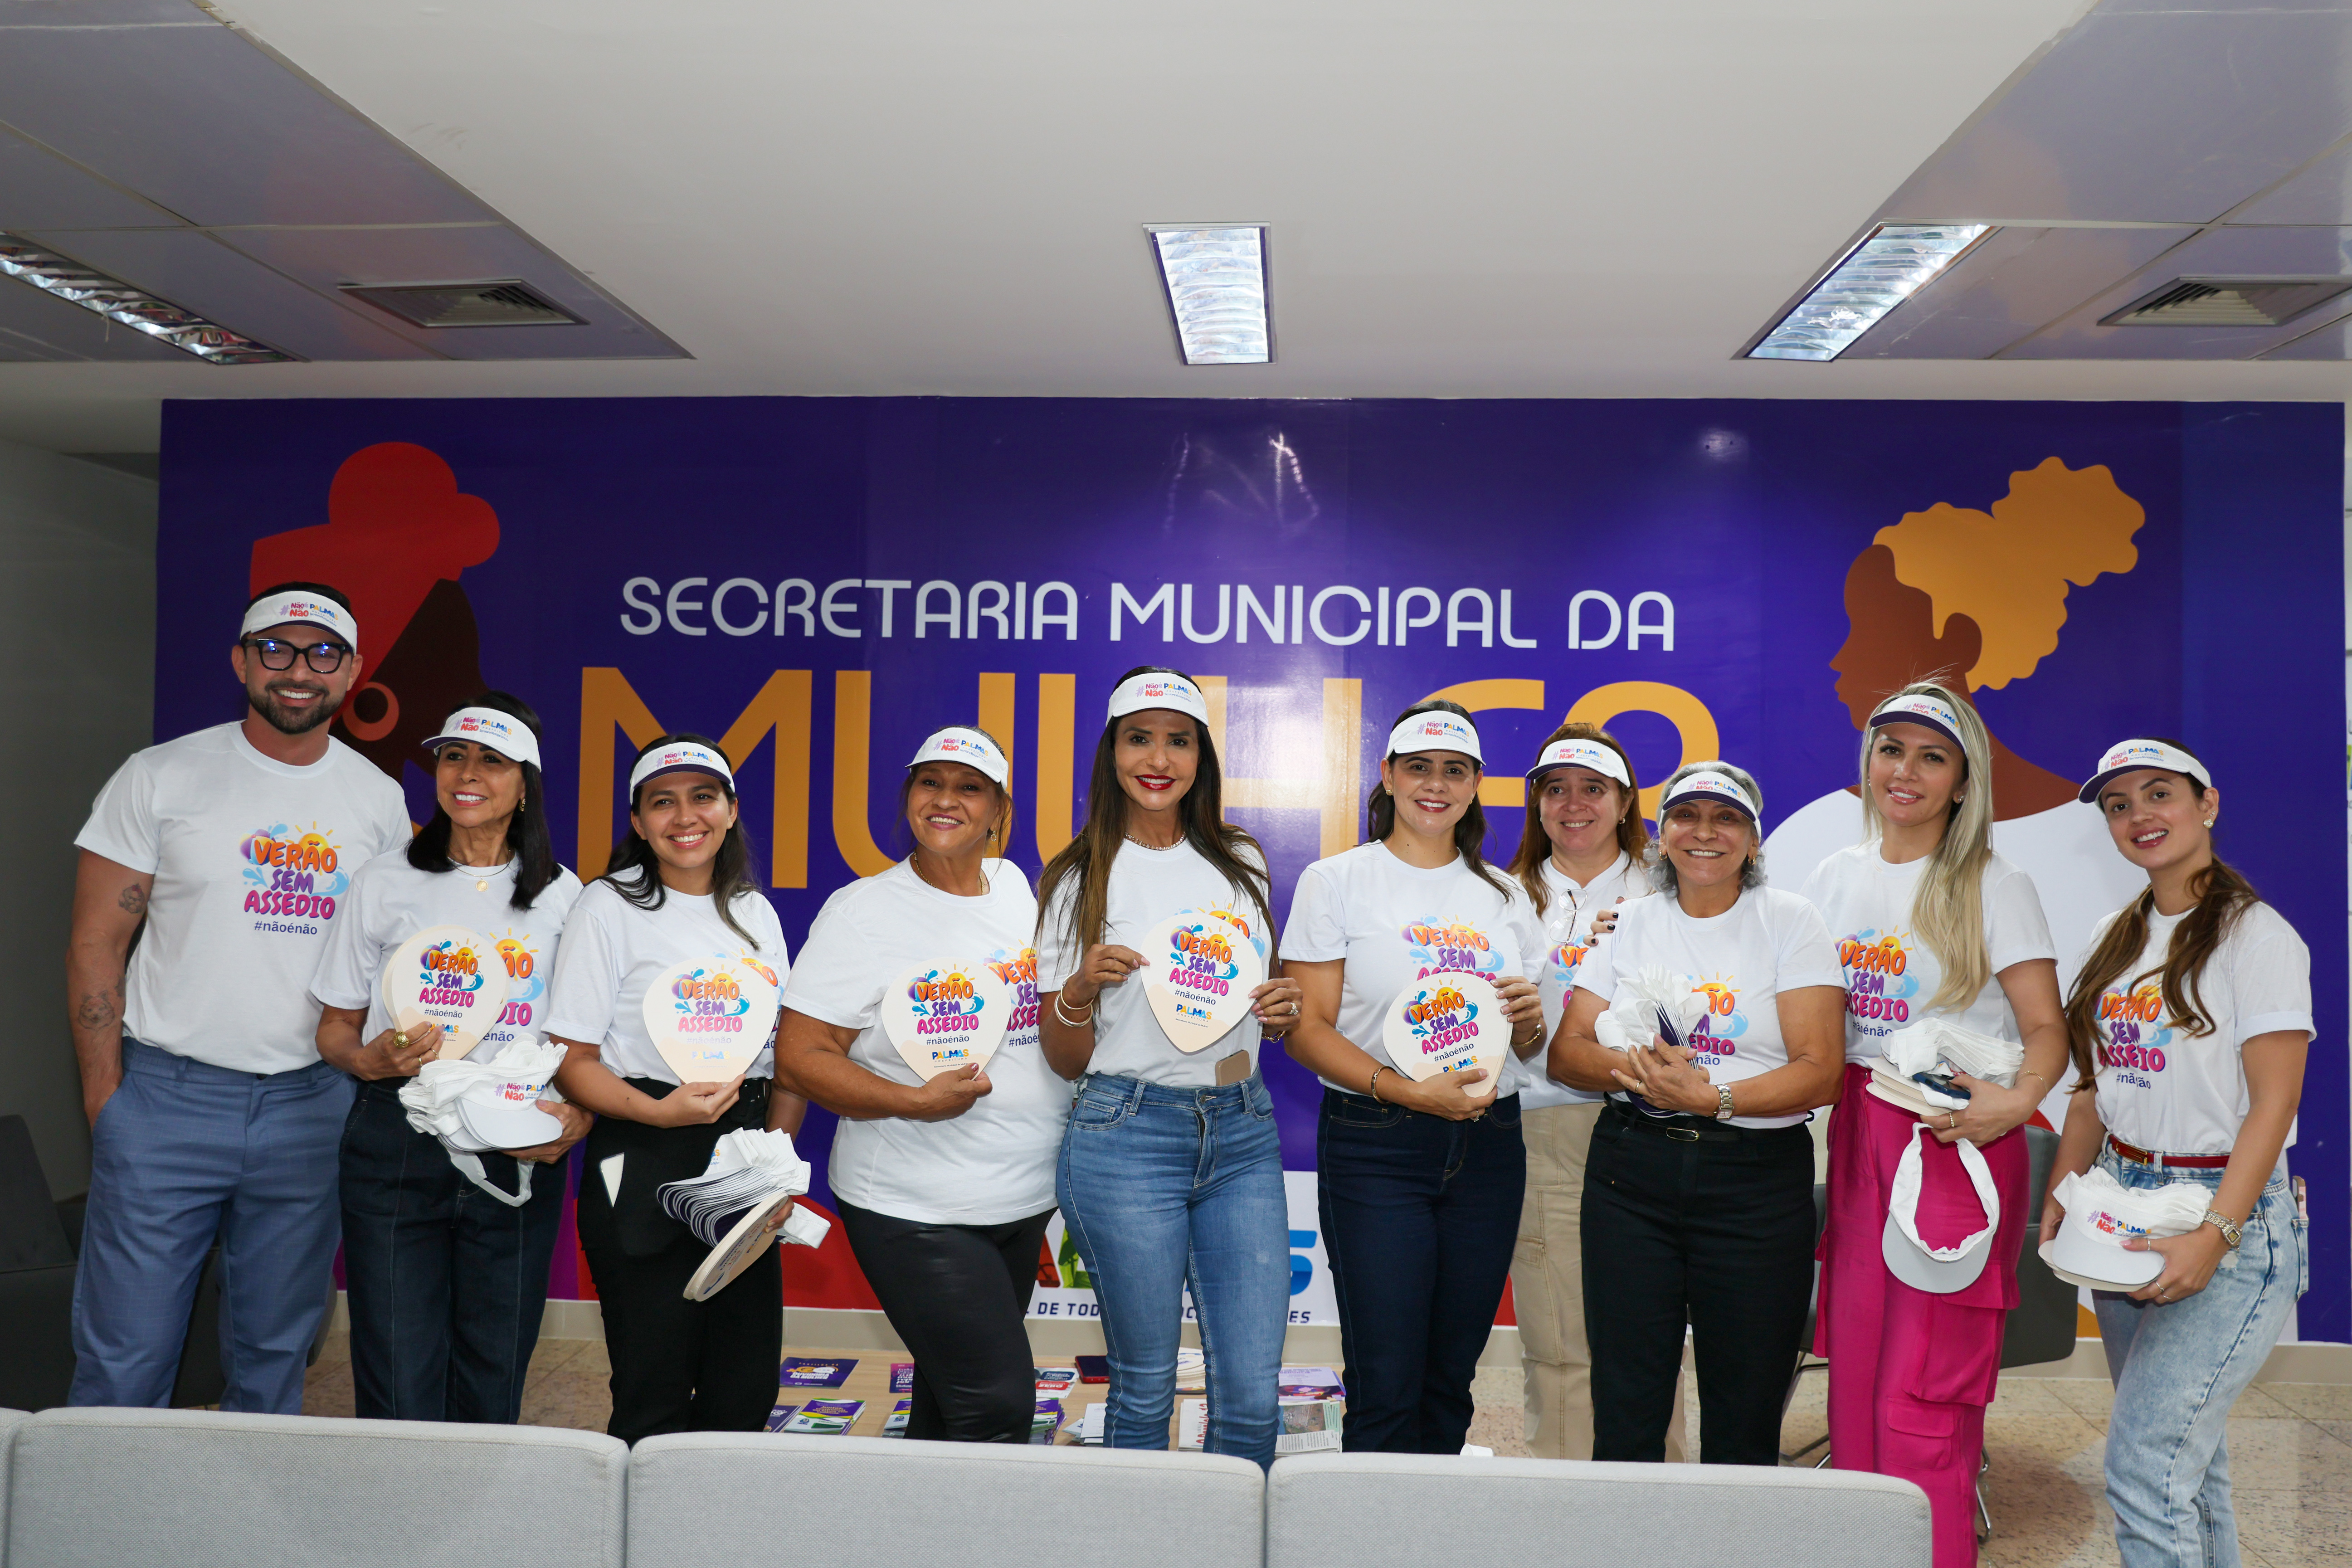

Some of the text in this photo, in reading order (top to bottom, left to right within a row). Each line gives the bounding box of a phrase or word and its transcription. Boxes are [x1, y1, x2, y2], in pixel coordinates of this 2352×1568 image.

[289, 608, 309, 617] Não
[310, 604, 338, 620] PALMAS
[620, 576, 1675, 651] SECRETARIA MUNICIPAL DA
[1145, 688, 1163, 696] Não
[1164, 683, 1192, 696] PALMAS
[1931, 706, 1959, 727] PALMAS
[460, 723, 479, 731] Não
[481, 720, 512, 735] PALMAS
[1426, 726, 1443, 735] Não
[1444, 723, 1469, 737] PALMAS
[961, 740, 989, 756] PALMAS
[1576, 748, 1603, 759] PALMAS
[683, 751, 712, 762] PALMAS
[2111, 756, 2128, 768] Não
[1714, 781, 1741, 798] PALMAS
[254, 840, 337, 874] VERÃO
[270, 868, 314, 894] SEM
[244, 887, 336, 920] ASSÉDIO
[254, 920, 317, 935] #nãoénão
[1412, 928, 1490, 951] VERÃO
[1180, 933, 1232, 964] VERÃO
[429, 953, 478, 975] VERÃO
[1188, 955, 1216, 976] SEM
[1438, 947, 1475, 969] SEM
[1841, 942, 1906, 976] VERÃO
[436, 973, 463, 989] SEM
[681, 978, 740, 1000] VERÃO
[1169, 968, 1229, 996] ASSÉDIO
[1850, 970, 1884, 997] SEM
[419, 985, 474, 1008] ASSÉDIO
[916, 978, 974, 1001] VERÃO
[1174, 989, 1216, 1005] #nãoénão
[424, 1008, 463, 1018] #nãoénão
[695, 1000, 725, 1016] SEM
[932, 1000, 961, 1017] SEM
[1176, 1004, 1212, 1020] PALMAS
[1410, 991, 1465, 1024] VERÃO
[678, 1012, 742, 1032] ASSÉDIO
[917, 1013, 979, 1035] ASSÉDIO
[1178, 1013, 1208, 1023] PREFEITURA
[1430, 1013, 1458, 1035] SEM
[687, 1036, 731, 1044] #nãoénão
[926, 1035, 969, 1046] #nãoénão
[1008, 1032, 1039, 1047] #nãoé
[1421, 1021, 1479, 1055] ASSÉDIO
[2109, 1021, 2140, 1045] SEM
[691, 1051, 730, 1060] PALMAS
[932, 1049, 969, 1060] PALMAS
[1434, 1043, 1474, 1062] #nãoénão
[1443, 1056, 1478, 1072] PALMAS
[505, 1089, 524, 1101] Não
[2096, 1219, 2115, 1234] Não
[2117, 1220, 2152, 1234] PALMAS
[1038, 1303, 1059, 1314] DE
